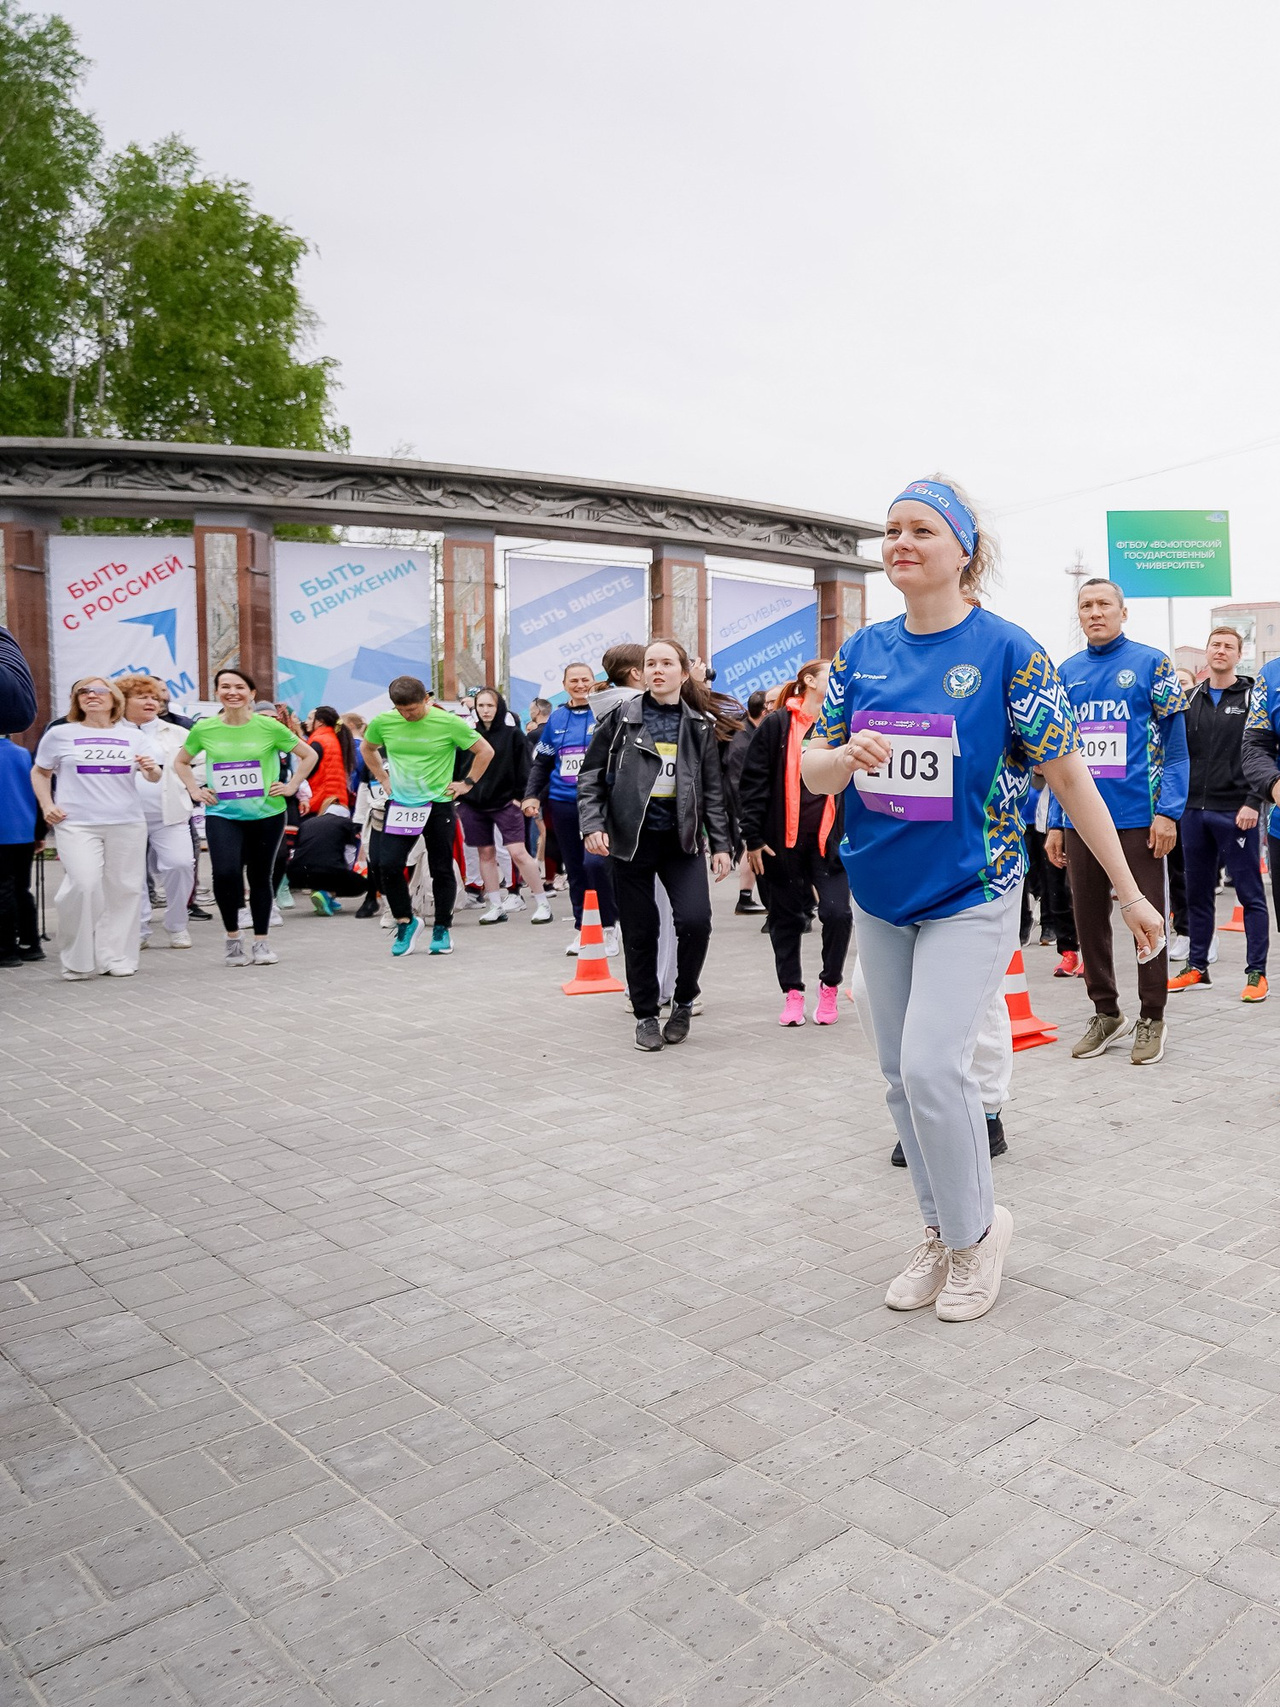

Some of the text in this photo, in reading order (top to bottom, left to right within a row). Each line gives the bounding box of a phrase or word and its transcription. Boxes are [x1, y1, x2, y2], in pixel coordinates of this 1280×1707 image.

[1116, 541, 1148, 549] ФГБОУ
[1124, 550, 1216, 560] ГОСУДАРСТВЕННЫЙ
[67, 562, 128, 599] БЫТЬ
[300, 562, 365, 597] БЫТЬ
[1135, 561, 1205, 570] УНИВЕРСИТЕТ»
[63, 554, 183, 630] С РОССИЕЙ
[289, 559, 417, 624] В ДВИЖЕНИИ
[520, 575, 634, 636] БЫТЬ ВМЕСТЕ
[720, 597, 793, 638] ФЕСТИВАЛЬ
[559, 631, 604, 657] БЫТЬ
[724, 630, 806, 685] ДВИЖЕНИЕ
[544, 669, 557, 682] С
[728, 653, 806, 702] ЕРВЫХ
[84, 749, 126, 760] 2244
[867, 749, 939, 781] 103
[221, 773, 257, 787] 2100
[395, 811, 426, 822] 2185
